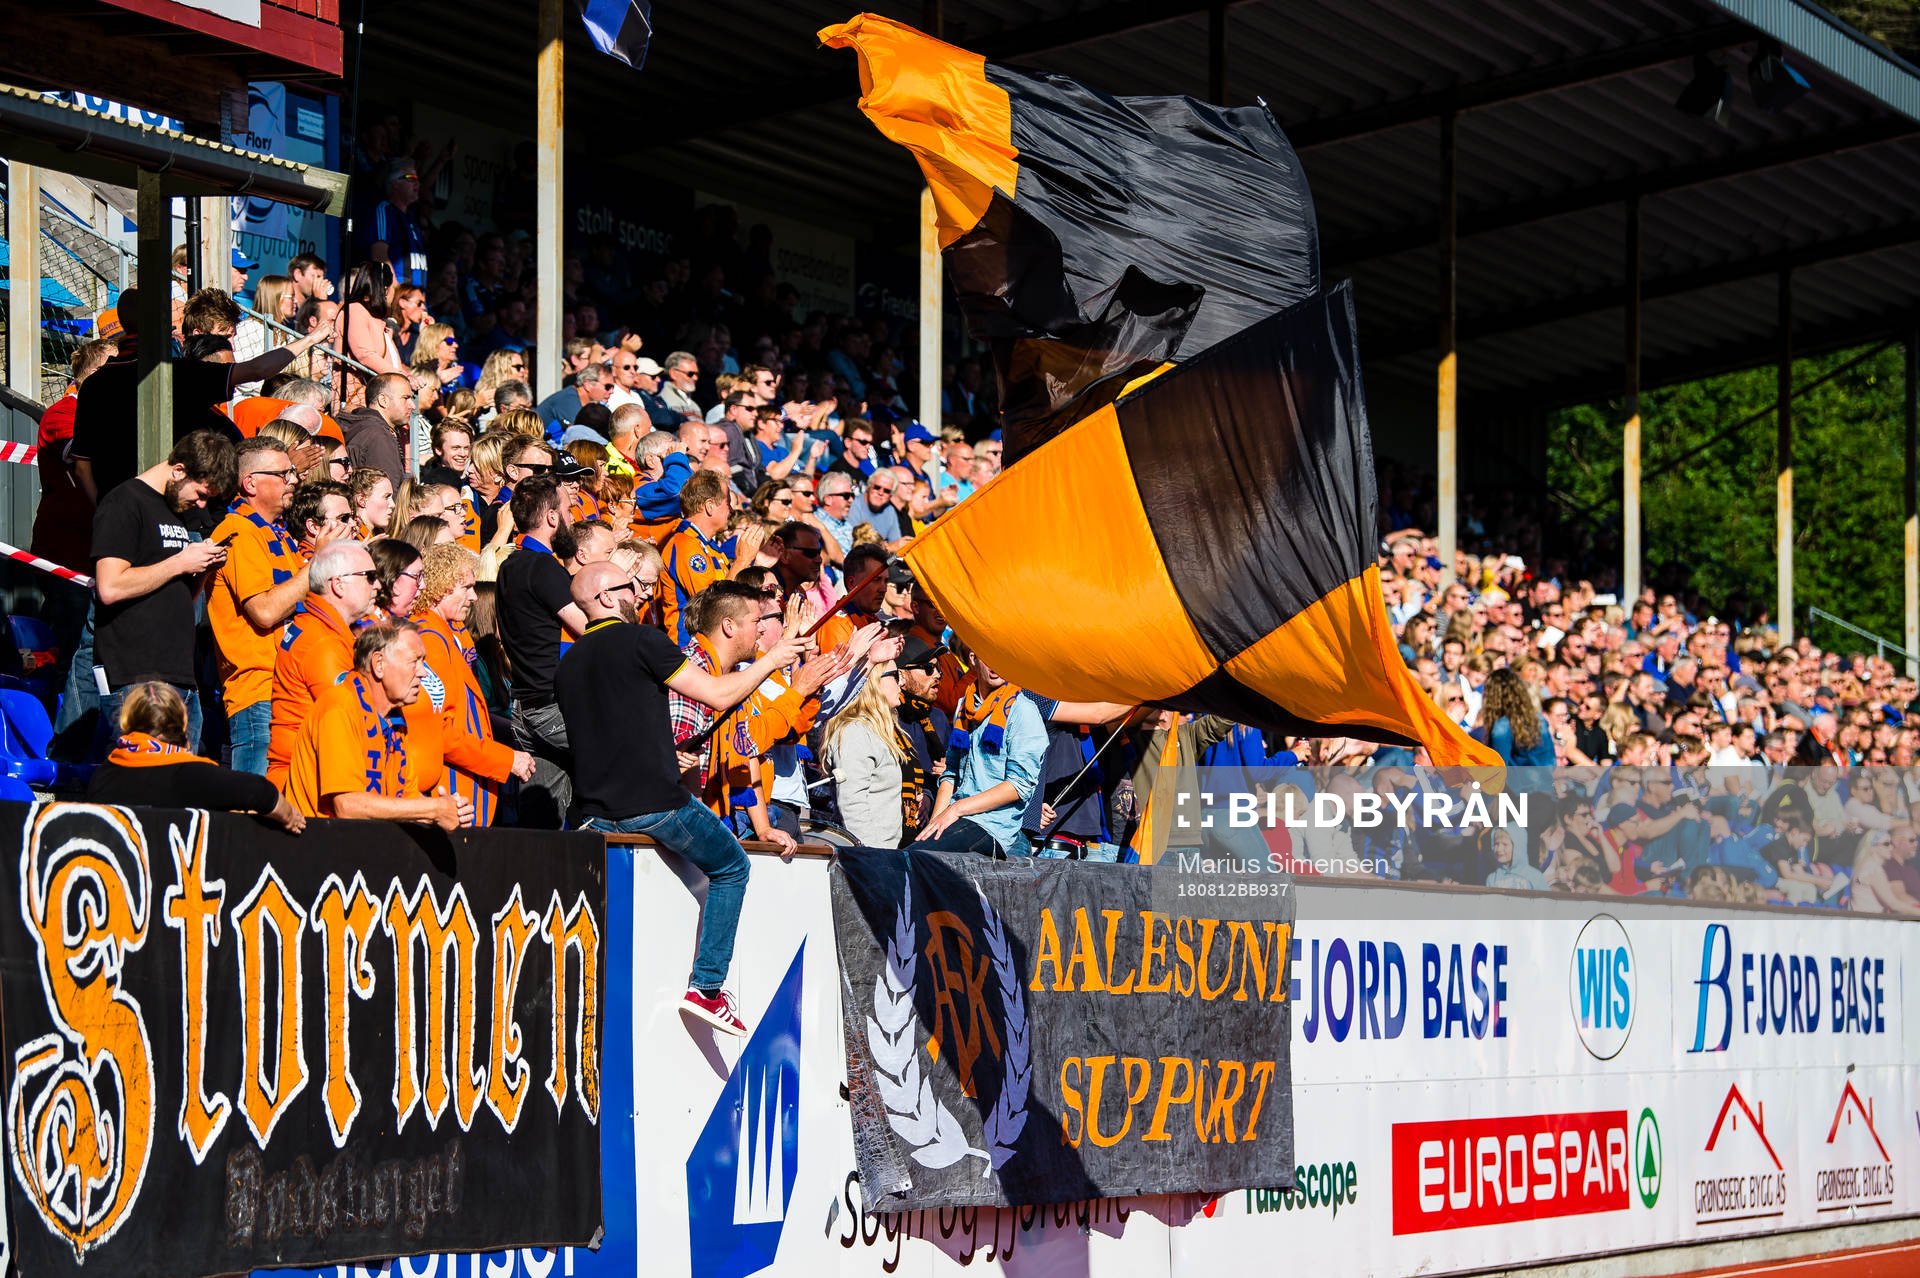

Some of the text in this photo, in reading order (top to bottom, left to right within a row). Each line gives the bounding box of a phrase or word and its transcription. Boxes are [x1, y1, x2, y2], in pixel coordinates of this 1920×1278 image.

[1422, 943, 1508, 1039] BASE
[1577, 945, 1630, 1030] WIS
[1742, 952, 1885, 1036] FJORD BASE
[8, 800, 601, 1266] Stormen
[1418, 1127, 1628, 1214] EUROSPAR
